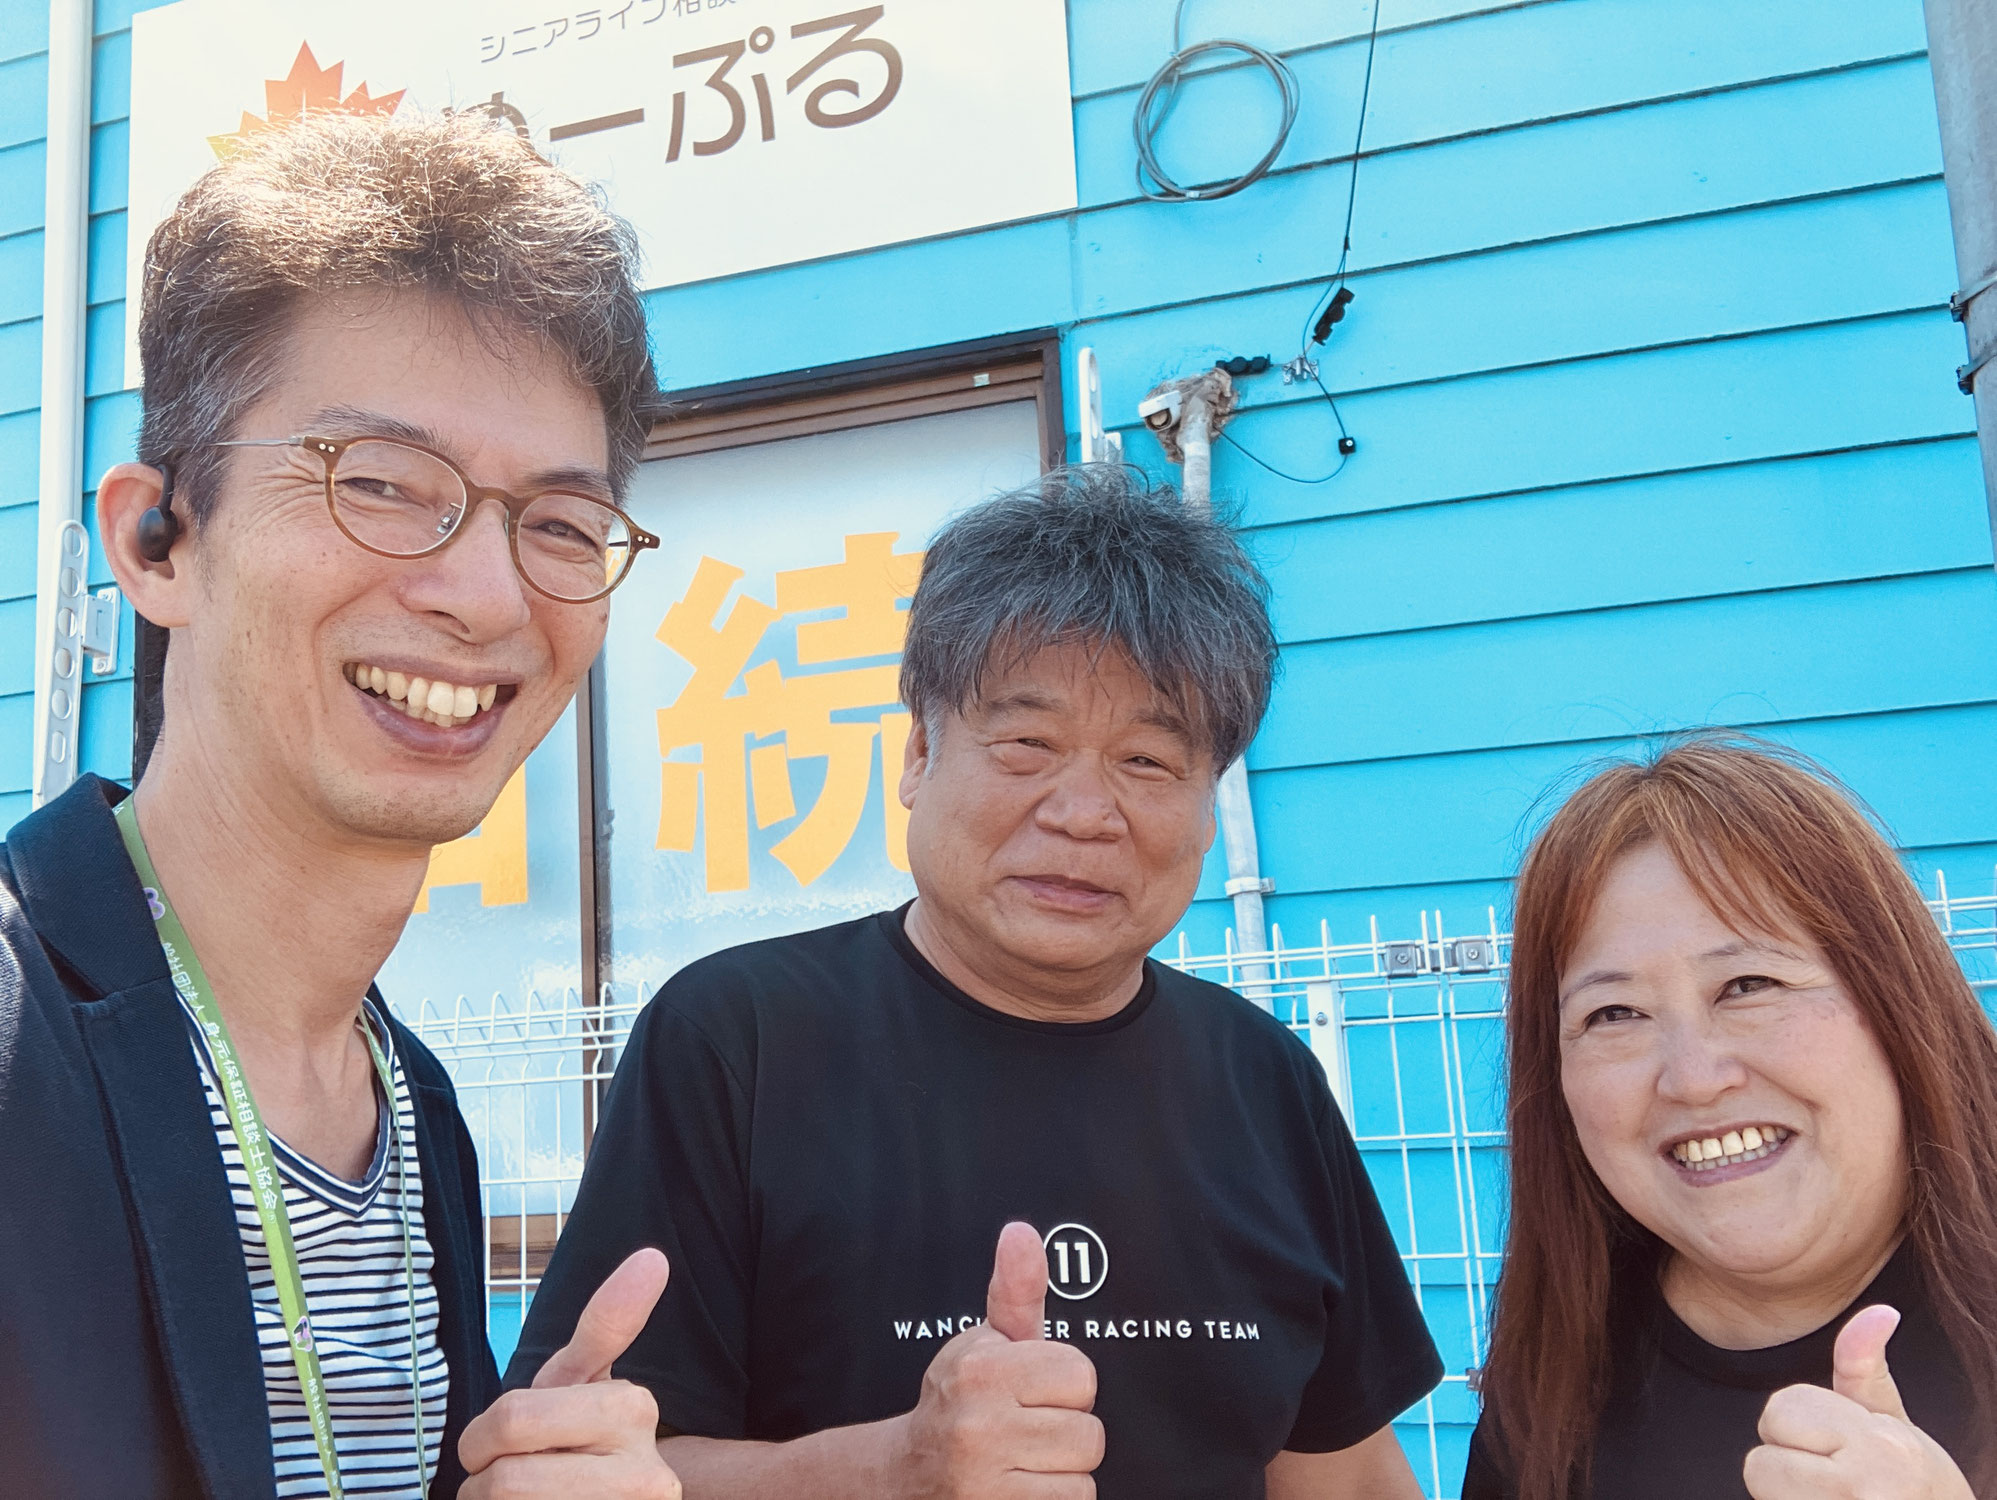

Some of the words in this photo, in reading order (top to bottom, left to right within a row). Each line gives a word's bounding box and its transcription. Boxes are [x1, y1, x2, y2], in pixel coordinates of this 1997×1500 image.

[480, 0, 737, 63] シニアライフ相
[1054, 1241, 1091, 1284] 11
[1085, 1319, 1193, 1339] RACING
[1204, 1320, 1260, 1341] TEAM
